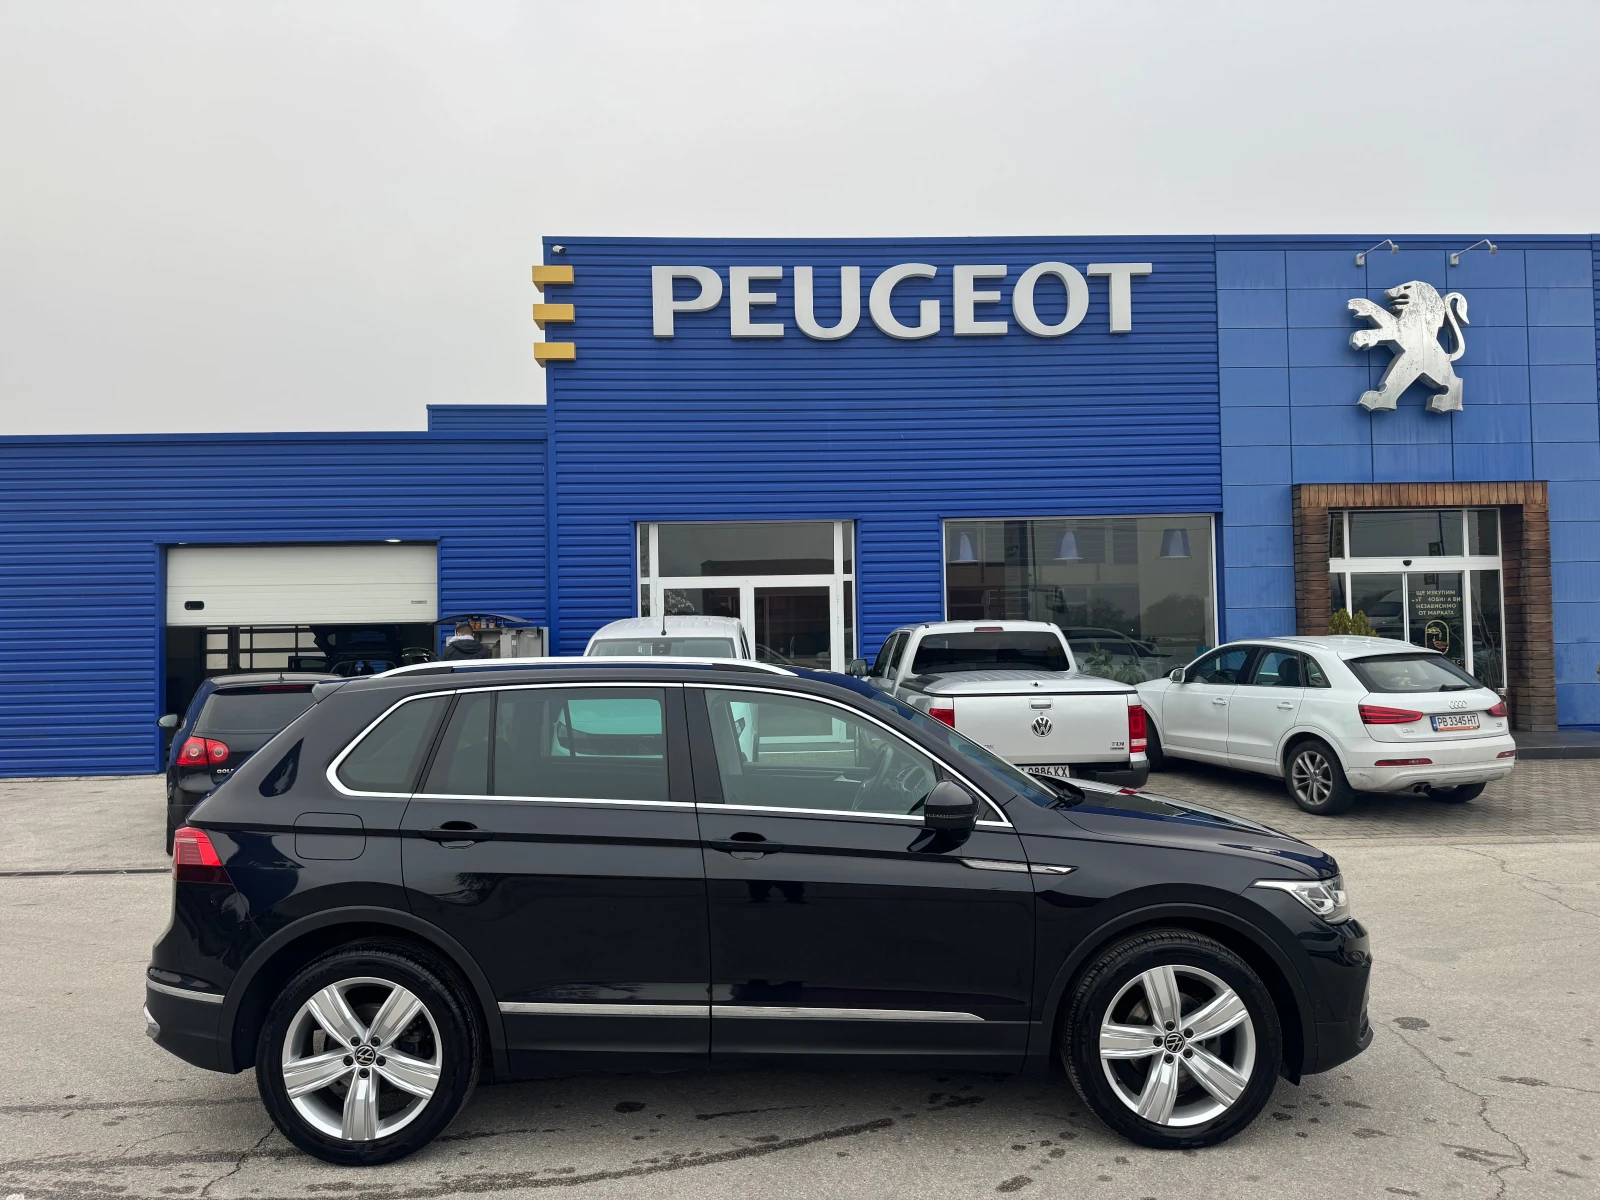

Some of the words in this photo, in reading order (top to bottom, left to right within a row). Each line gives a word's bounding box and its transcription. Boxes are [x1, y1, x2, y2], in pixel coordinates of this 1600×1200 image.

[651, 261, 1153, 341] PEUGEOT
[1437, 716, 1448, 727] PB
[1448, 715, 1467, 726] 3345
[1466, 715, 1477, 725] HT
[1054, 766, 1068, 777] KX
